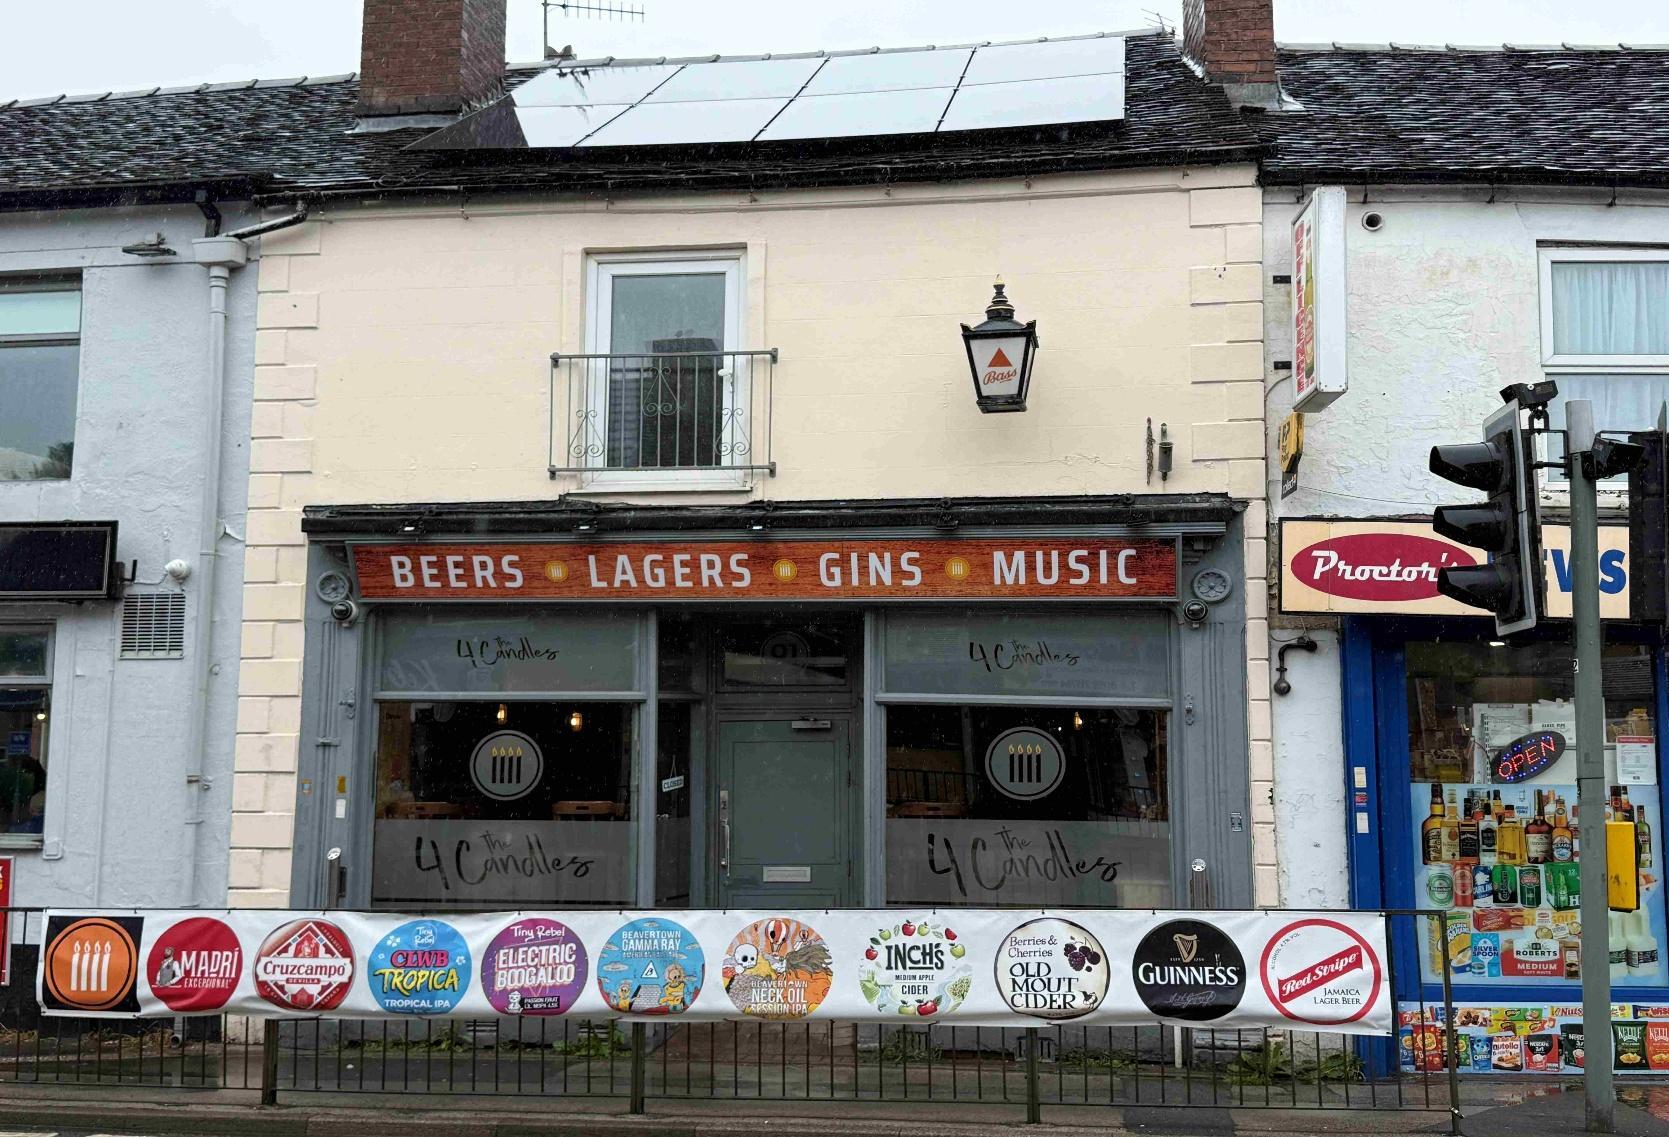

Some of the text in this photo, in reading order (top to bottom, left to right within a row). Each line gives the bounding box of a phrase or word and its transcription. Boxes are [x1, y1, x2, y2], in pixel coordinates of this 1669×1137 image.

[983, 368, 1017, 385] Bass
[390, 549, 1137, 589] BEERS LAGERS GINS MUSIC
[1312, 548, 1456, 582] Proctor'
[456, 637, 560, 668] 4 Candles
[969, 640, 1080, 673] 4 Candles
[1498, 736, 1555, 778] OPEN
[416, 834, 594, 890] 4 Candles
[928, 829, 1122, 897] 4 Candles
[416, 926, 433, 937] Tiny
[510, 925, 565, 942] Tiny Rebel
[622, 930, 681, 939] BEAVERTOWN
[622, 939, 681, 951] GAMMA RAY
[1009, 935, 1058, 947] Berries &
[390, 949, 450, 968] CLWB
[498, 942, 577, 969] ELECTRIC
[1008, 947, 1053, 958] Cherries
[181, 947, 241, 977] MADRÍ
[263, 961, 346, 977] Cruzcampo
[1009, 961, 1051, 978] OLD
[374, 967, 461, 998] TROPICA
[496, 964, 576, 989] BOOGALOO
[1138, 962, 1239, 986] GUINNESS
[1281, 953, 1357, 997] Red Stripe
[901, 984, 929, 995] CIDER
[1011, 977, 1079, 993] MOUT
[1324, 987, 1361, 996] JAMAICA
[384, 999, 451, 1008] TROPICAL IPA
[751, 988, 808, 1003] NECK OIL
[1010, 993, 1078, 1010] CIDER
[1314, 996, 1362, 1005] LAGER BEER
[751, 1003, 808, 1015] SESSION IPA
[1618, 1026, 1642, 1040] KETTLE
[1493, 1043, 1519, 1051] nutella
